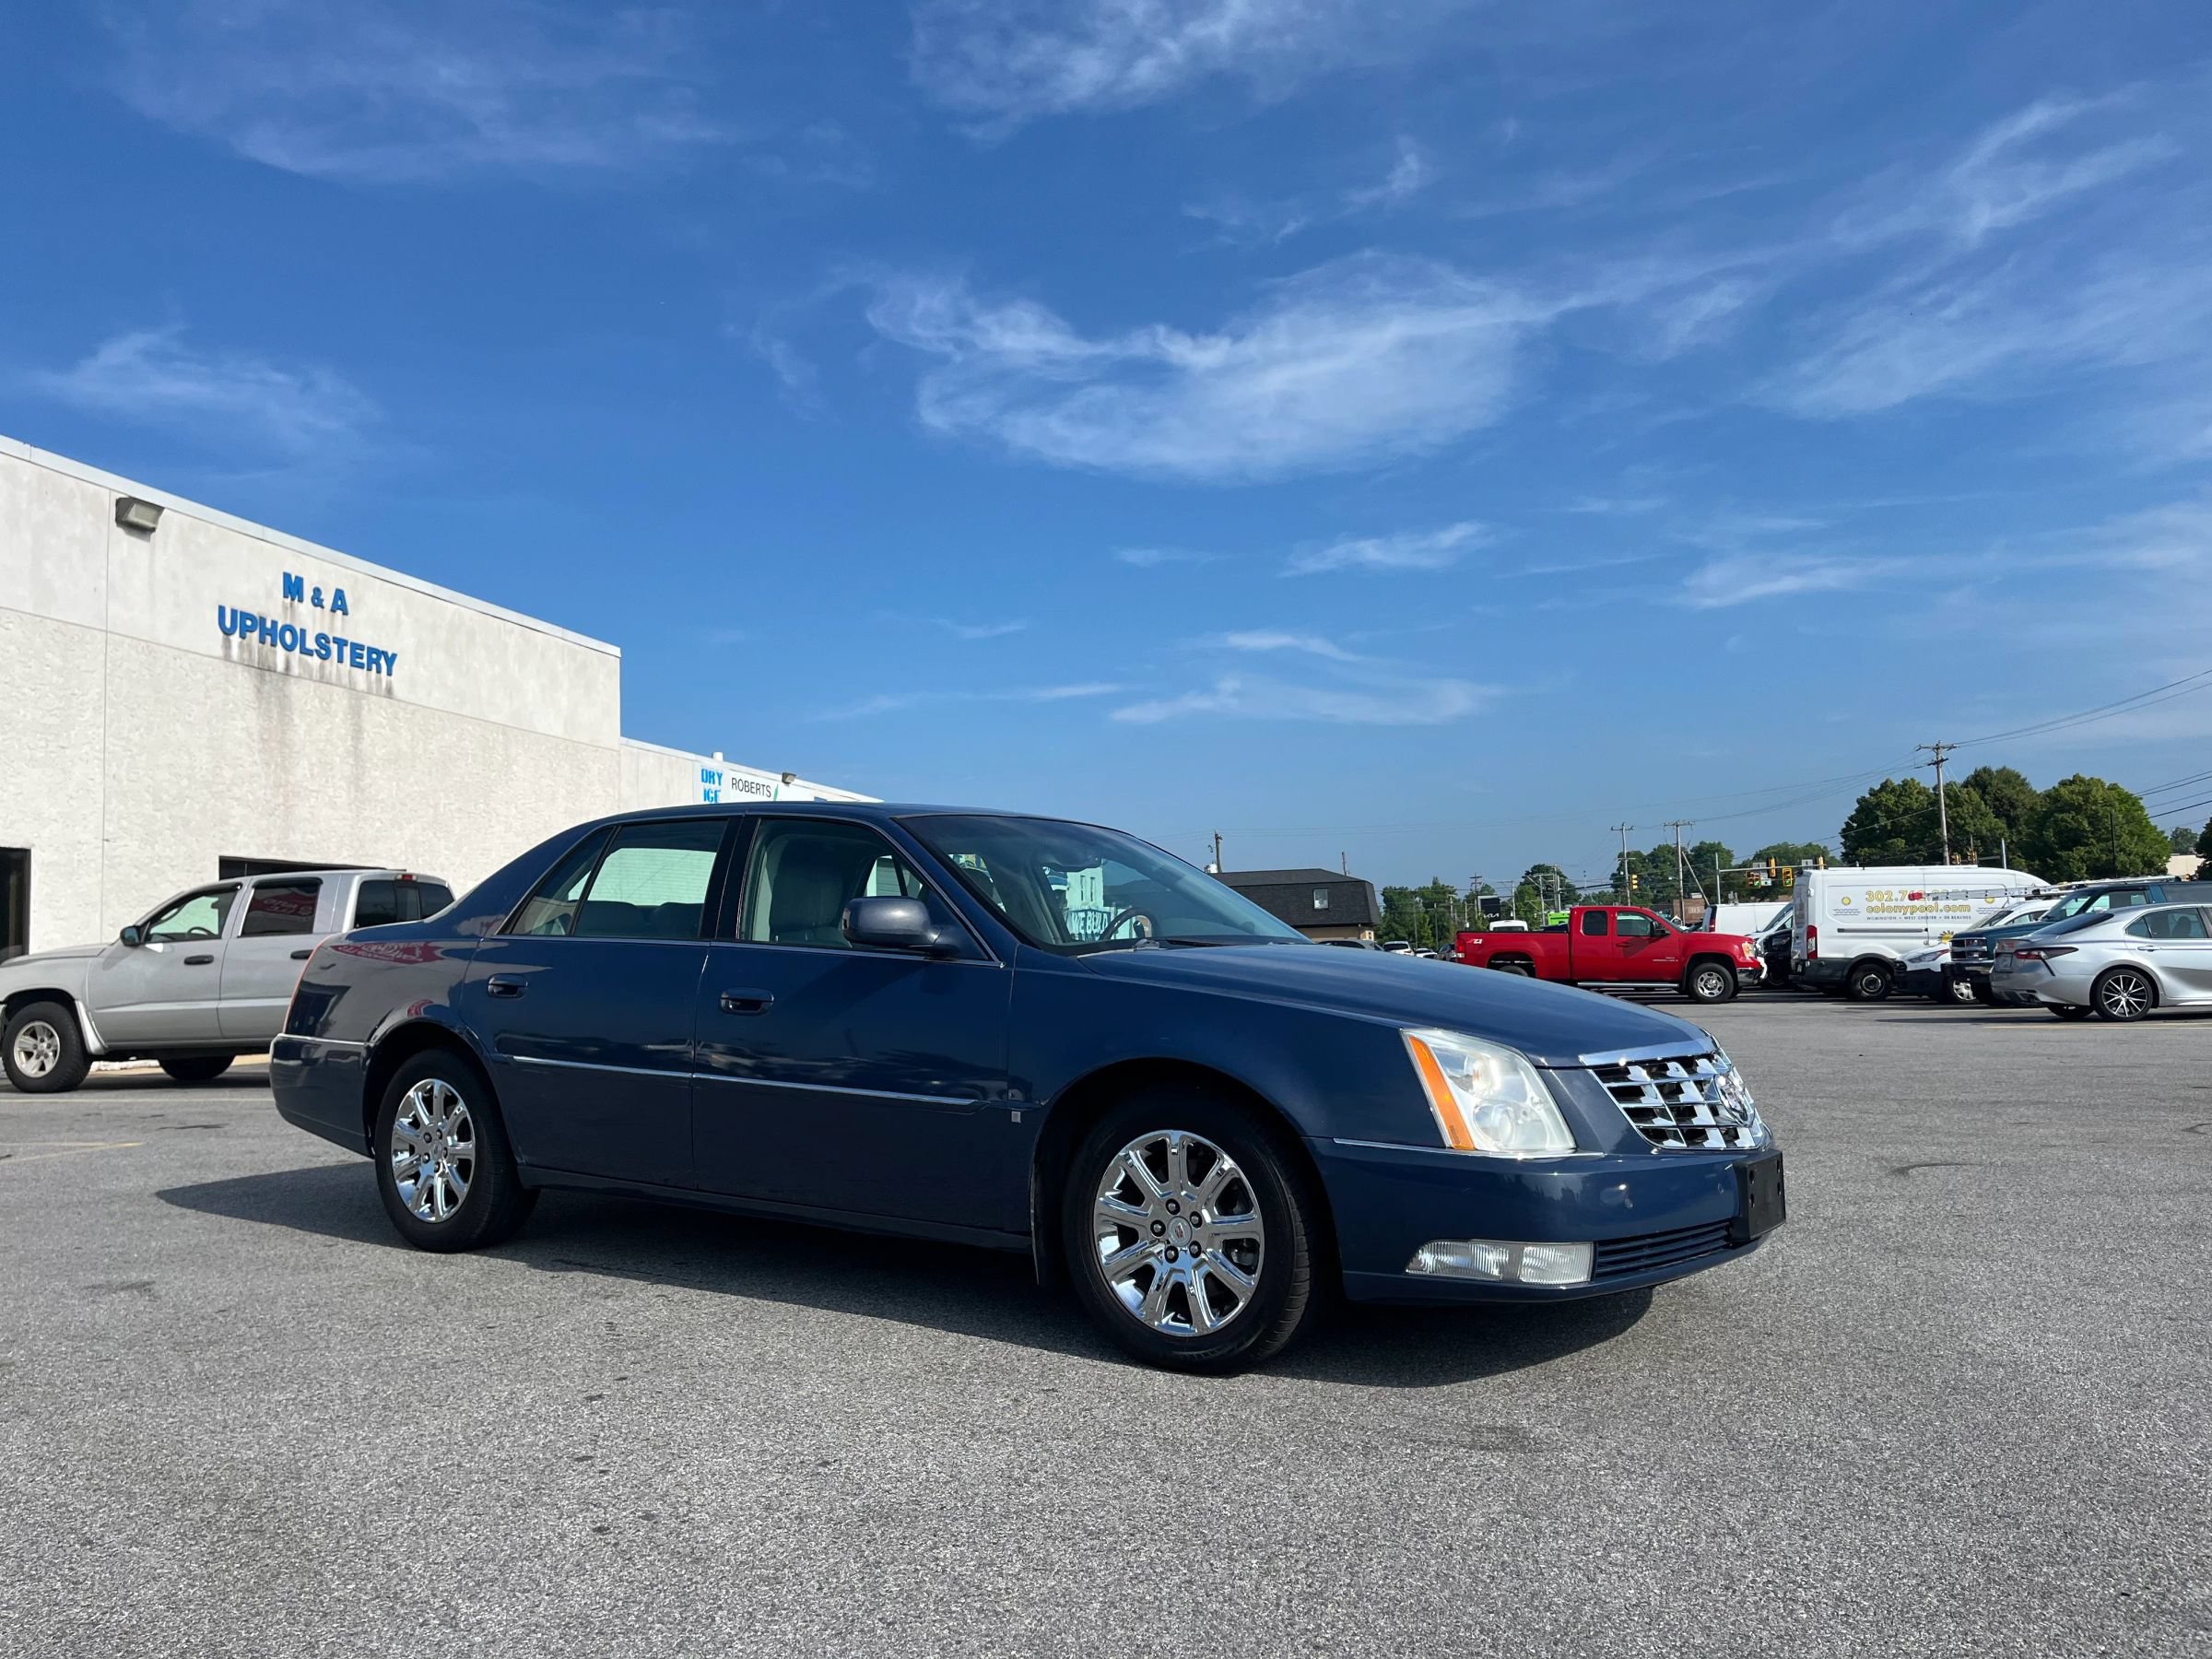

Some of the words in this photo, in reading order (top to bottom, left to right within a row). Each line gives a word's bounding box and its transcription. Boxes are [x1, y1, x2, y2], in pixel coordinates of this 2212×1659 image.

[283, 571, 304, 603] M
[311, 586, 324, 609] &
[330, 588, 348, 616] A
[218, 605, 398, 677] UPHOLSTERY
[702, 769, 723, 786] DRY
[732, 778, 771, 798] ROBERTS
[1866, 902, 1971, 915] colonypool.com
